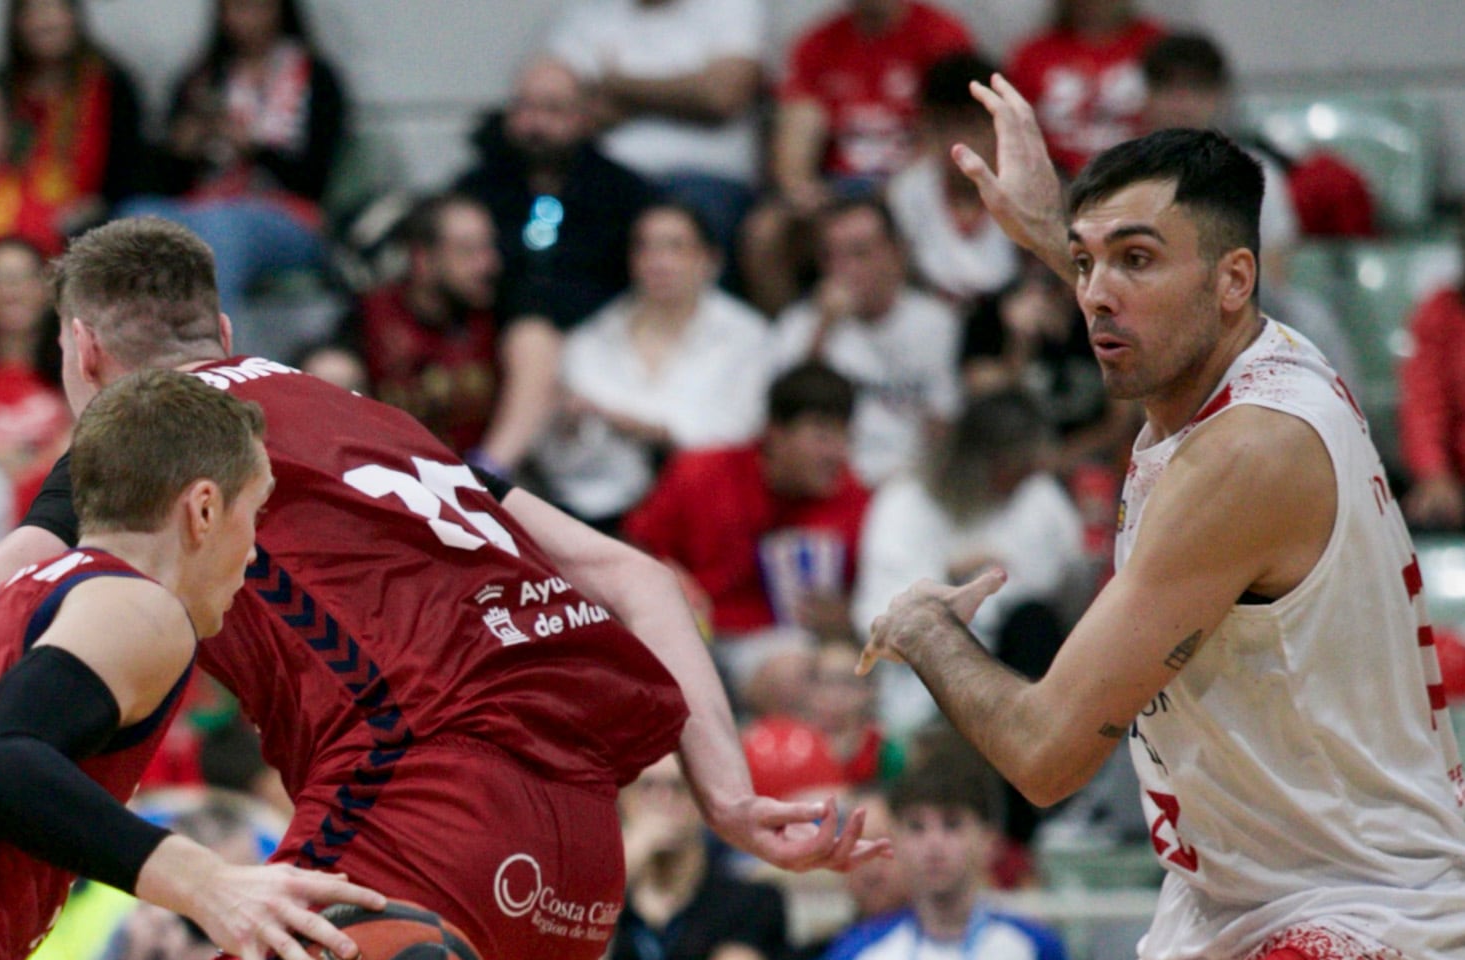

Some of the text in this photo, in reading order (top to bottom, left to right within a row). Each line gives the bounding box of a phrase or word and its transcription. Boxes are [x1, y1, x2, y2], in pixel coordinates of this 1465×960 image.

[520, 576, 572, 607] Ayu
[535, 612, 564, 638] de
[539, 886, 586, 922] Costa
